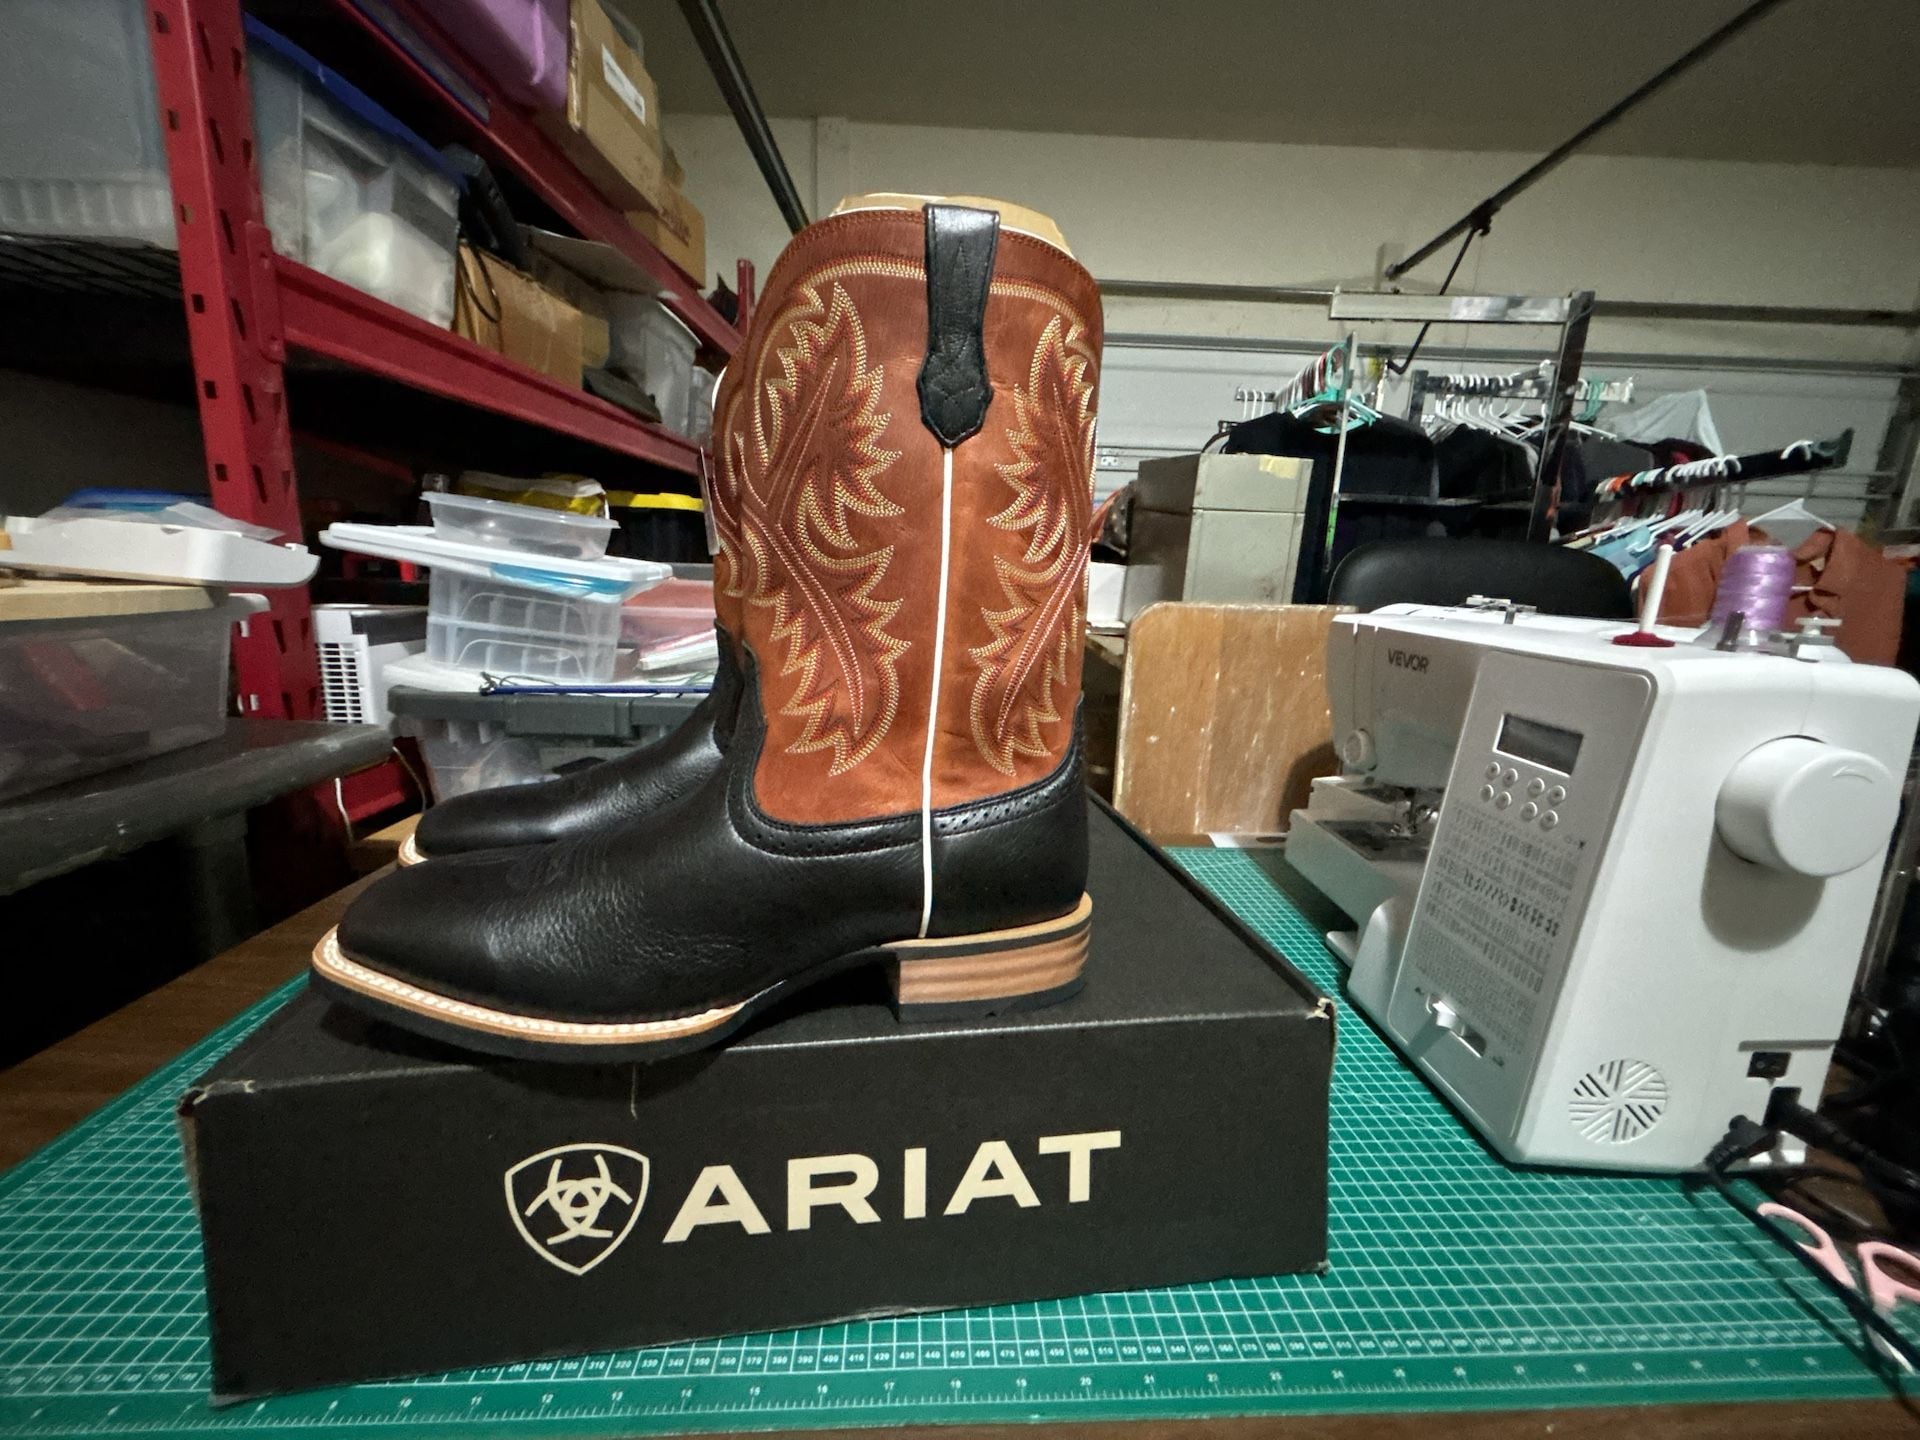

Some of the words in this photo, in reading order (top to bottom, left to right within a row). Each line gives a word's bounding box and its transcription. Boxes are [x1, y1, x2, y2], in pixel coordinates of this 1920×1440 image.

[1388, 648, 1429, 674] VEVOR
[662, 1130, 1121, 1243] ARIAT
[668, 1358, 684, 1367] 340
[849, 1353, 865, 1362] 410
[874, 1352, 890, 1361] 420
[899, 1351, 915, 1360] 430
[925, 1350, 941, 1359] 440
[1122, 1346, 1138, 1354] 520
[681, 1388, 692, 1398] 14
[749, 1386, 761, 1396] 15
[883, 1381, 895, 1391] 17
[1080, 1376, 1092, 1386] 20
